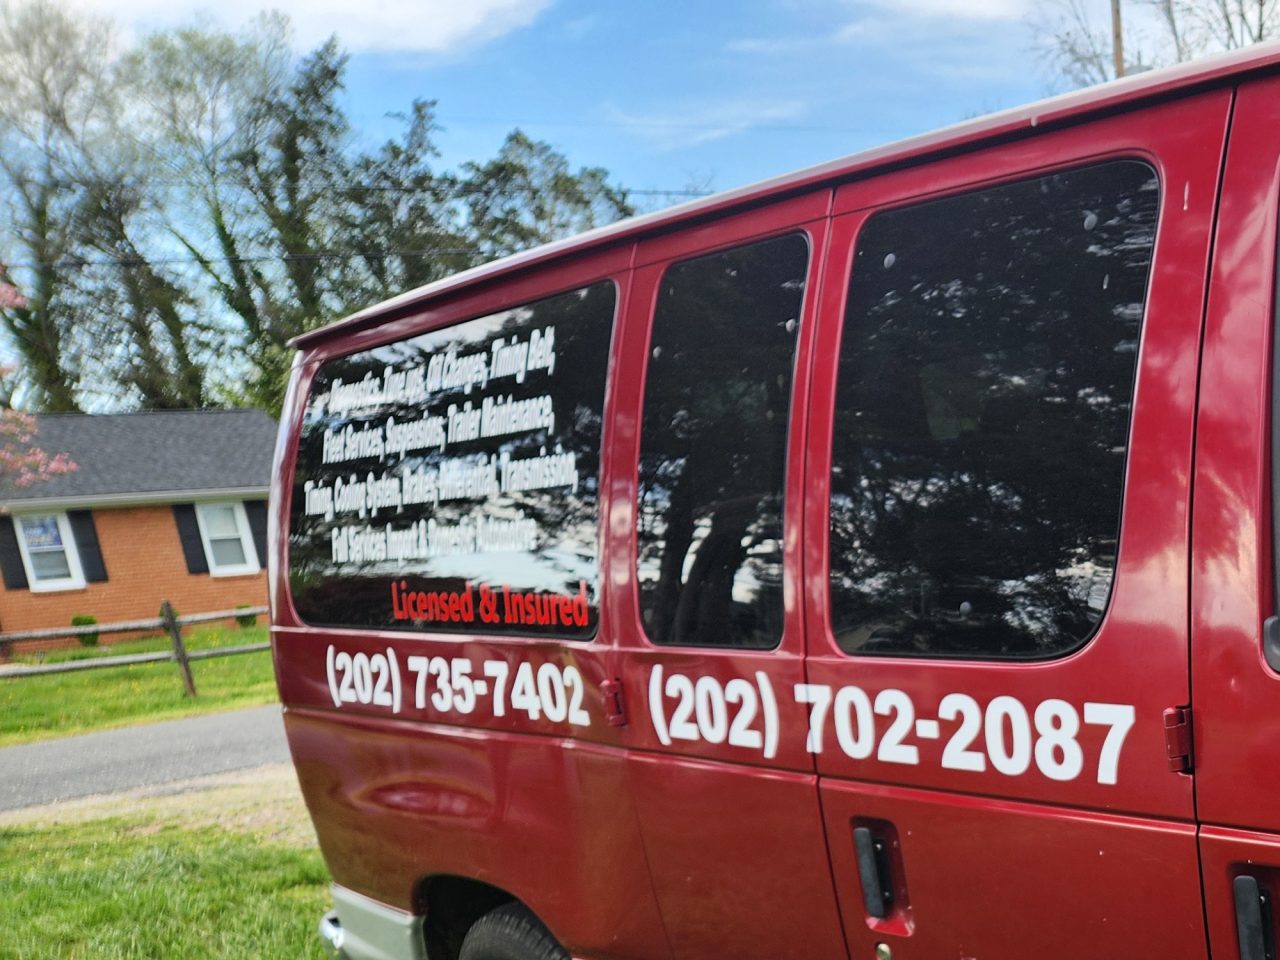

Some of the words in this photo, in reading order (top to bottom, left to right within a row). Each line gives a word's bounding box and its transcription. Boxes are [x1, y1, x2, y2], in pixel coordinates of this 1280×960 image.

[490, 334, 529, 384] Timing
[322, 426, 346, 464] Fleet
[345, 420, 384, 463] Services,
[447, 400, 481, 443] Trailer
[480, 393, 555, 436] Maintenance,
[500, 443, 578, 494] Transmission,
[391, 580, 475, 623] Licensed
[479, 582, 500, 623] &
[502, 579, 589, 627] Insured
[326, 644, 402, 714] (202)
[407, 655, 591, 727] 735-7402
[648, 664, 779, 759] (202)
[794, 683, 1135, 785] 702-2087
